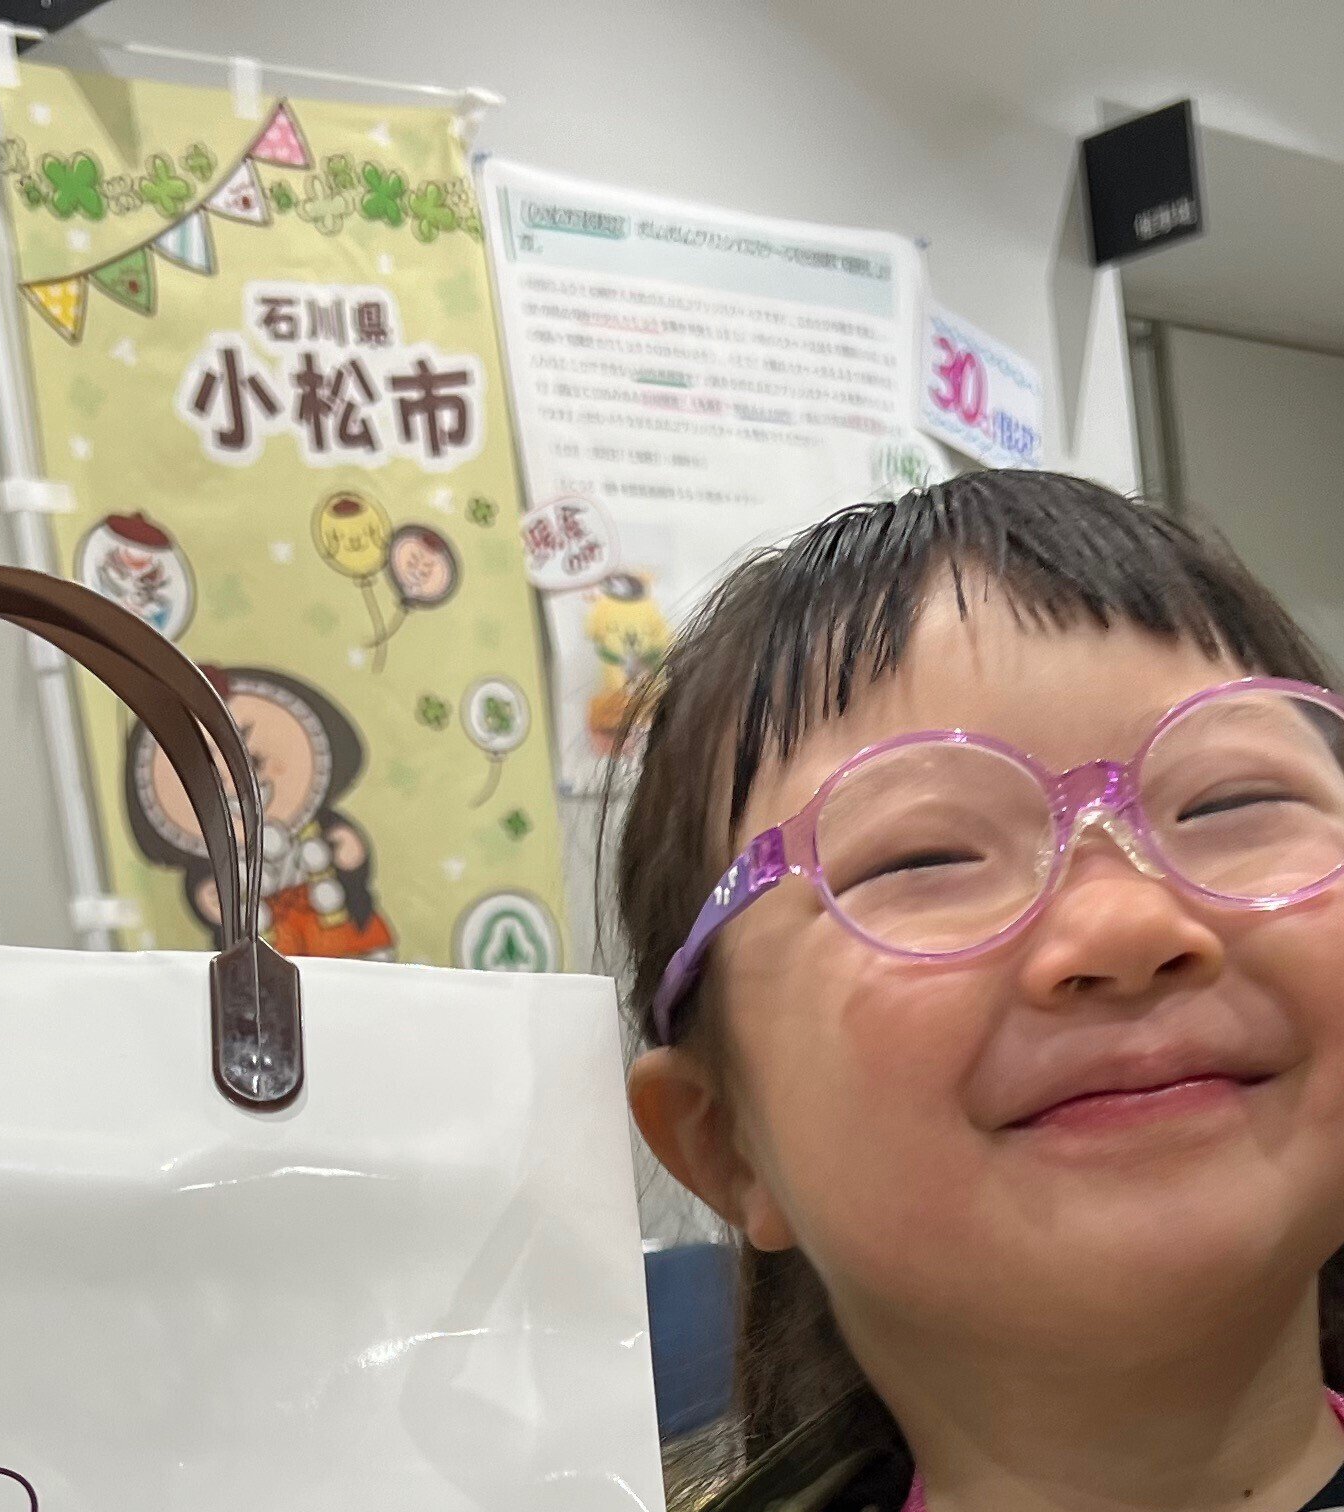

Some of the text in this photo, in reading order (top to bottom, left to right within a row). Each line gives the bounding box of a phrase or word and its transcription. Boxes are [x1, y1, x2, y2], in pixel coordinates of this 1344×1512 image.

[258, 295, 393, 347] 石川県
[192, 348, 470, 458] 小松市
